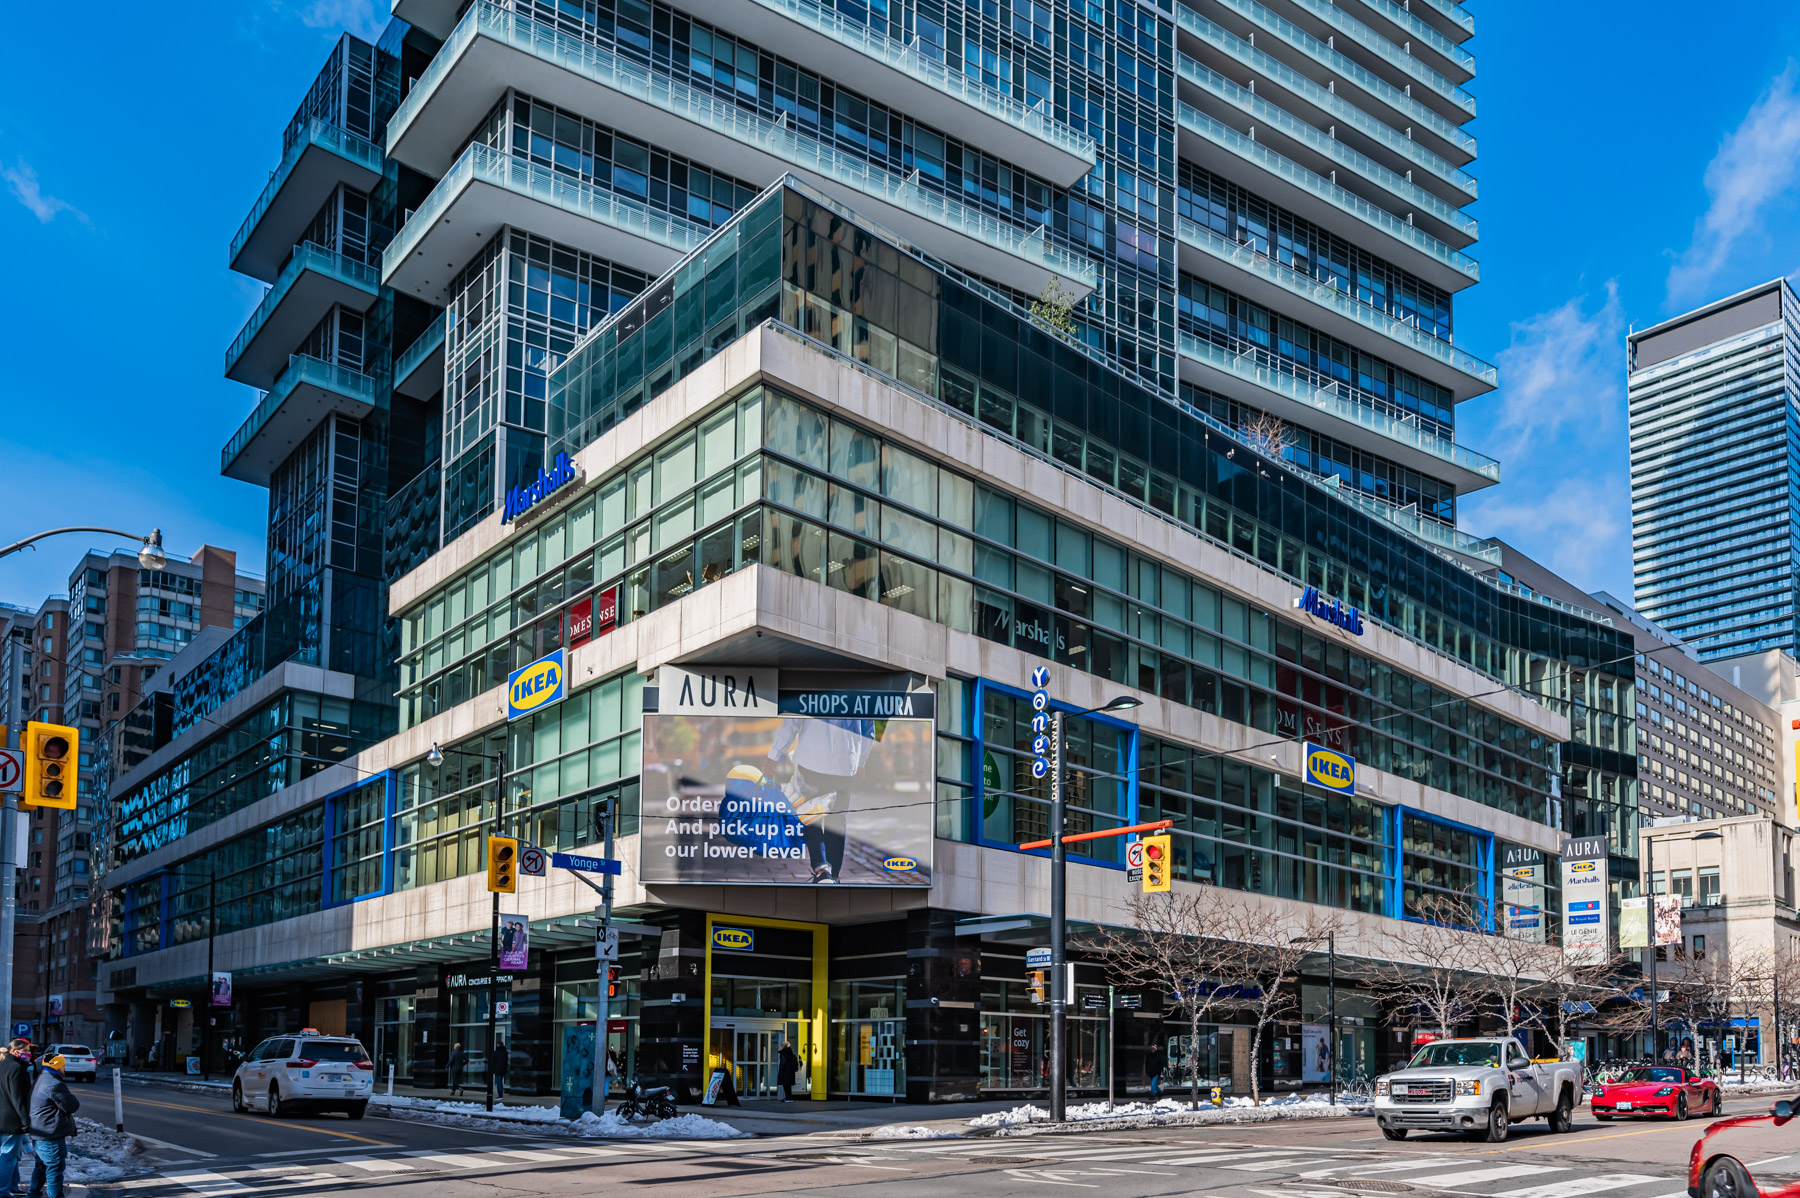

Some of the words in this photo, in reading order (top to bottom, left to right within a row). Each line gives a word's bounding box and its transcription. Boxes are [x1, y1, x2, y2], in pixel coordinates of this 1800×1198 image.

[501, 451, 576, 525] Marshalls
[1299, 586, 1364, 636] Marshalls
[514, 667, 558, 703] IKEA
[679, 674, 759, 708] AURA
[799, 693, 849, 715] SHOPS
[853, 695, 871, 715] AT
[874, 696, 914, 716] AURA
[1312, 756, 1351, 782] IKEA
[666, 796, 721, 813] Order
[726, 797, 792, 814] online.
[665, 820, 702, 835] And
[708, 820, 779, 840] pick-up
[784, 822, 804, 837] at
[665, 844, 698, 858] our
[703, 842, 758, 859] lower
[762, 843, 807, 860] level
[1566, 840, 1600, 857] AURA
[569, 855, 598, 871] Yonge
[1567, 875, 1600, 885] Marshalls
[716, 932, 750, 944] IKEA
[450, 974, 467, 988] AURA
[1014, 1027, 1027, 1037] Get
[1014, 1039, 1030, 1050] cozy
